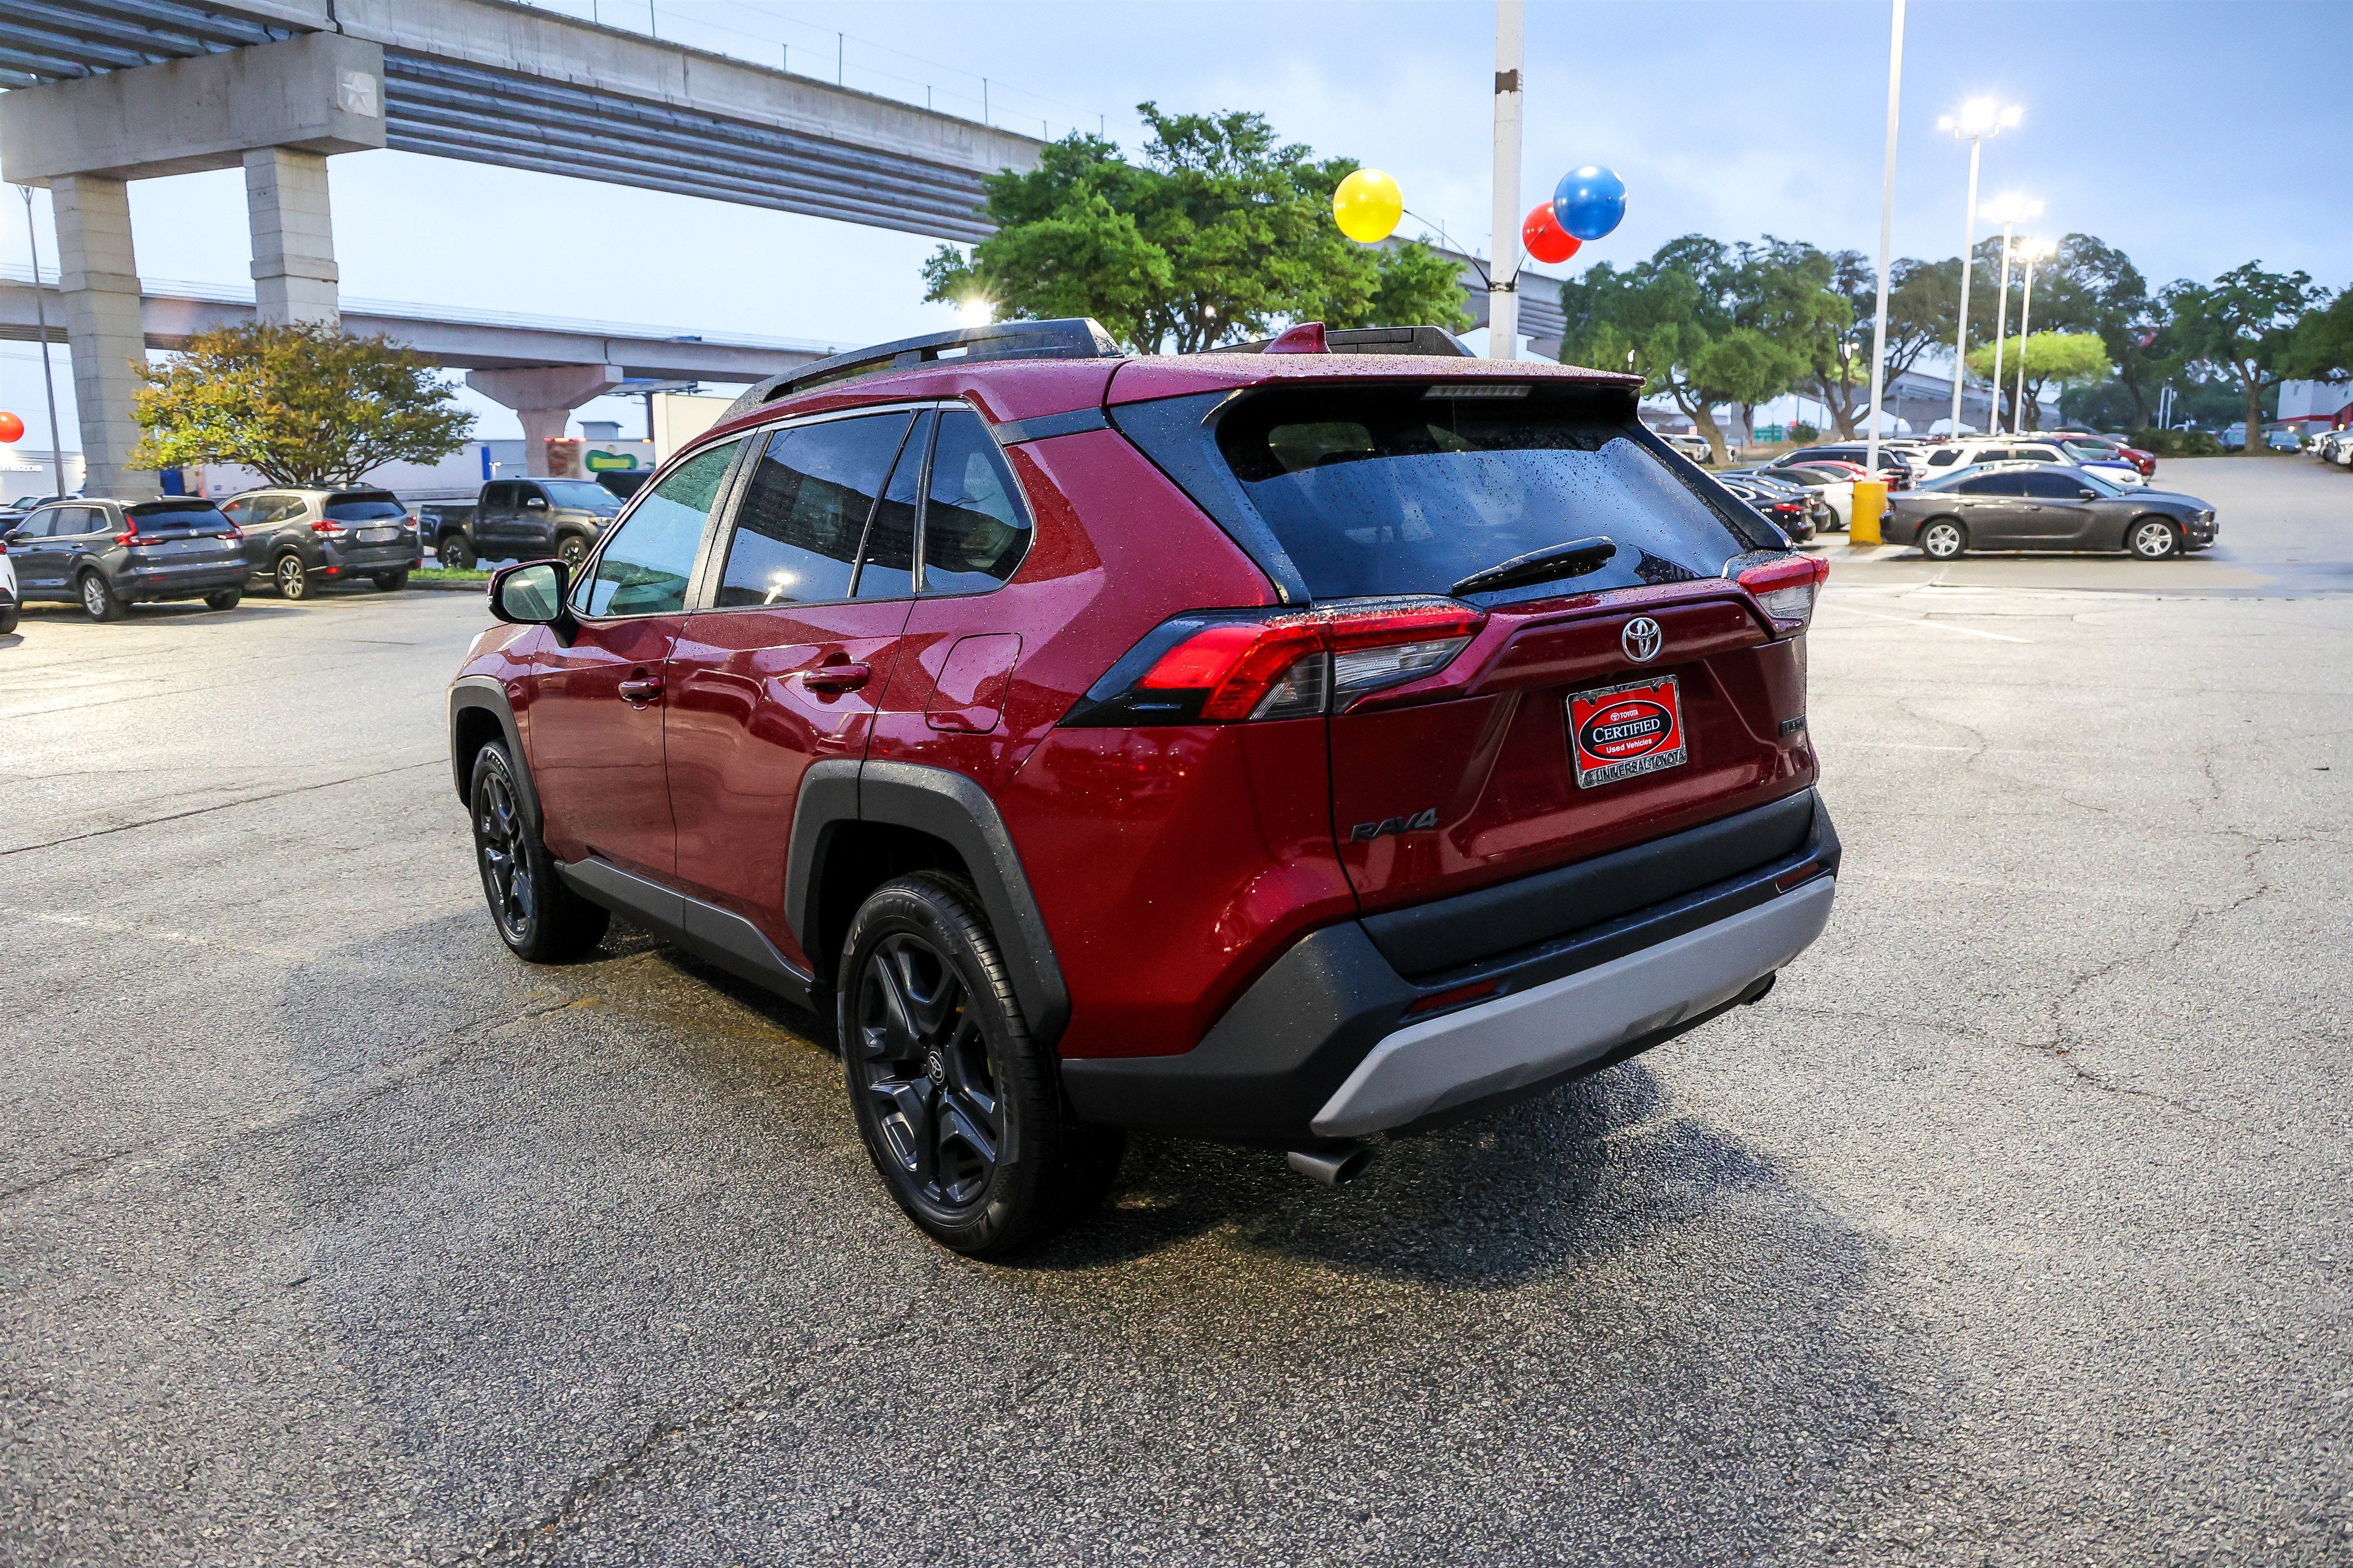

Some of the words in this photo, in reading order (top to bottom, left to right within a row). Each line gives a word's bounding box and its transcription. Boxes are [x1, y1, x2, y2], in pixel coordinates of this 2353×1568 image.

[1619, 709, 1639, 719] TOYOTA
[1592, 719, 1660, 743] CERTIFIED
[1606, 744, 1625, 754] Used
[1626, 738, 1652, 750] Vehicles
[1595, 758, 1650, 782] UNIVERSAL
[1649, 749, 1684, 771] TOYOTA
[1350, 807, 1438, 843] RAV4
